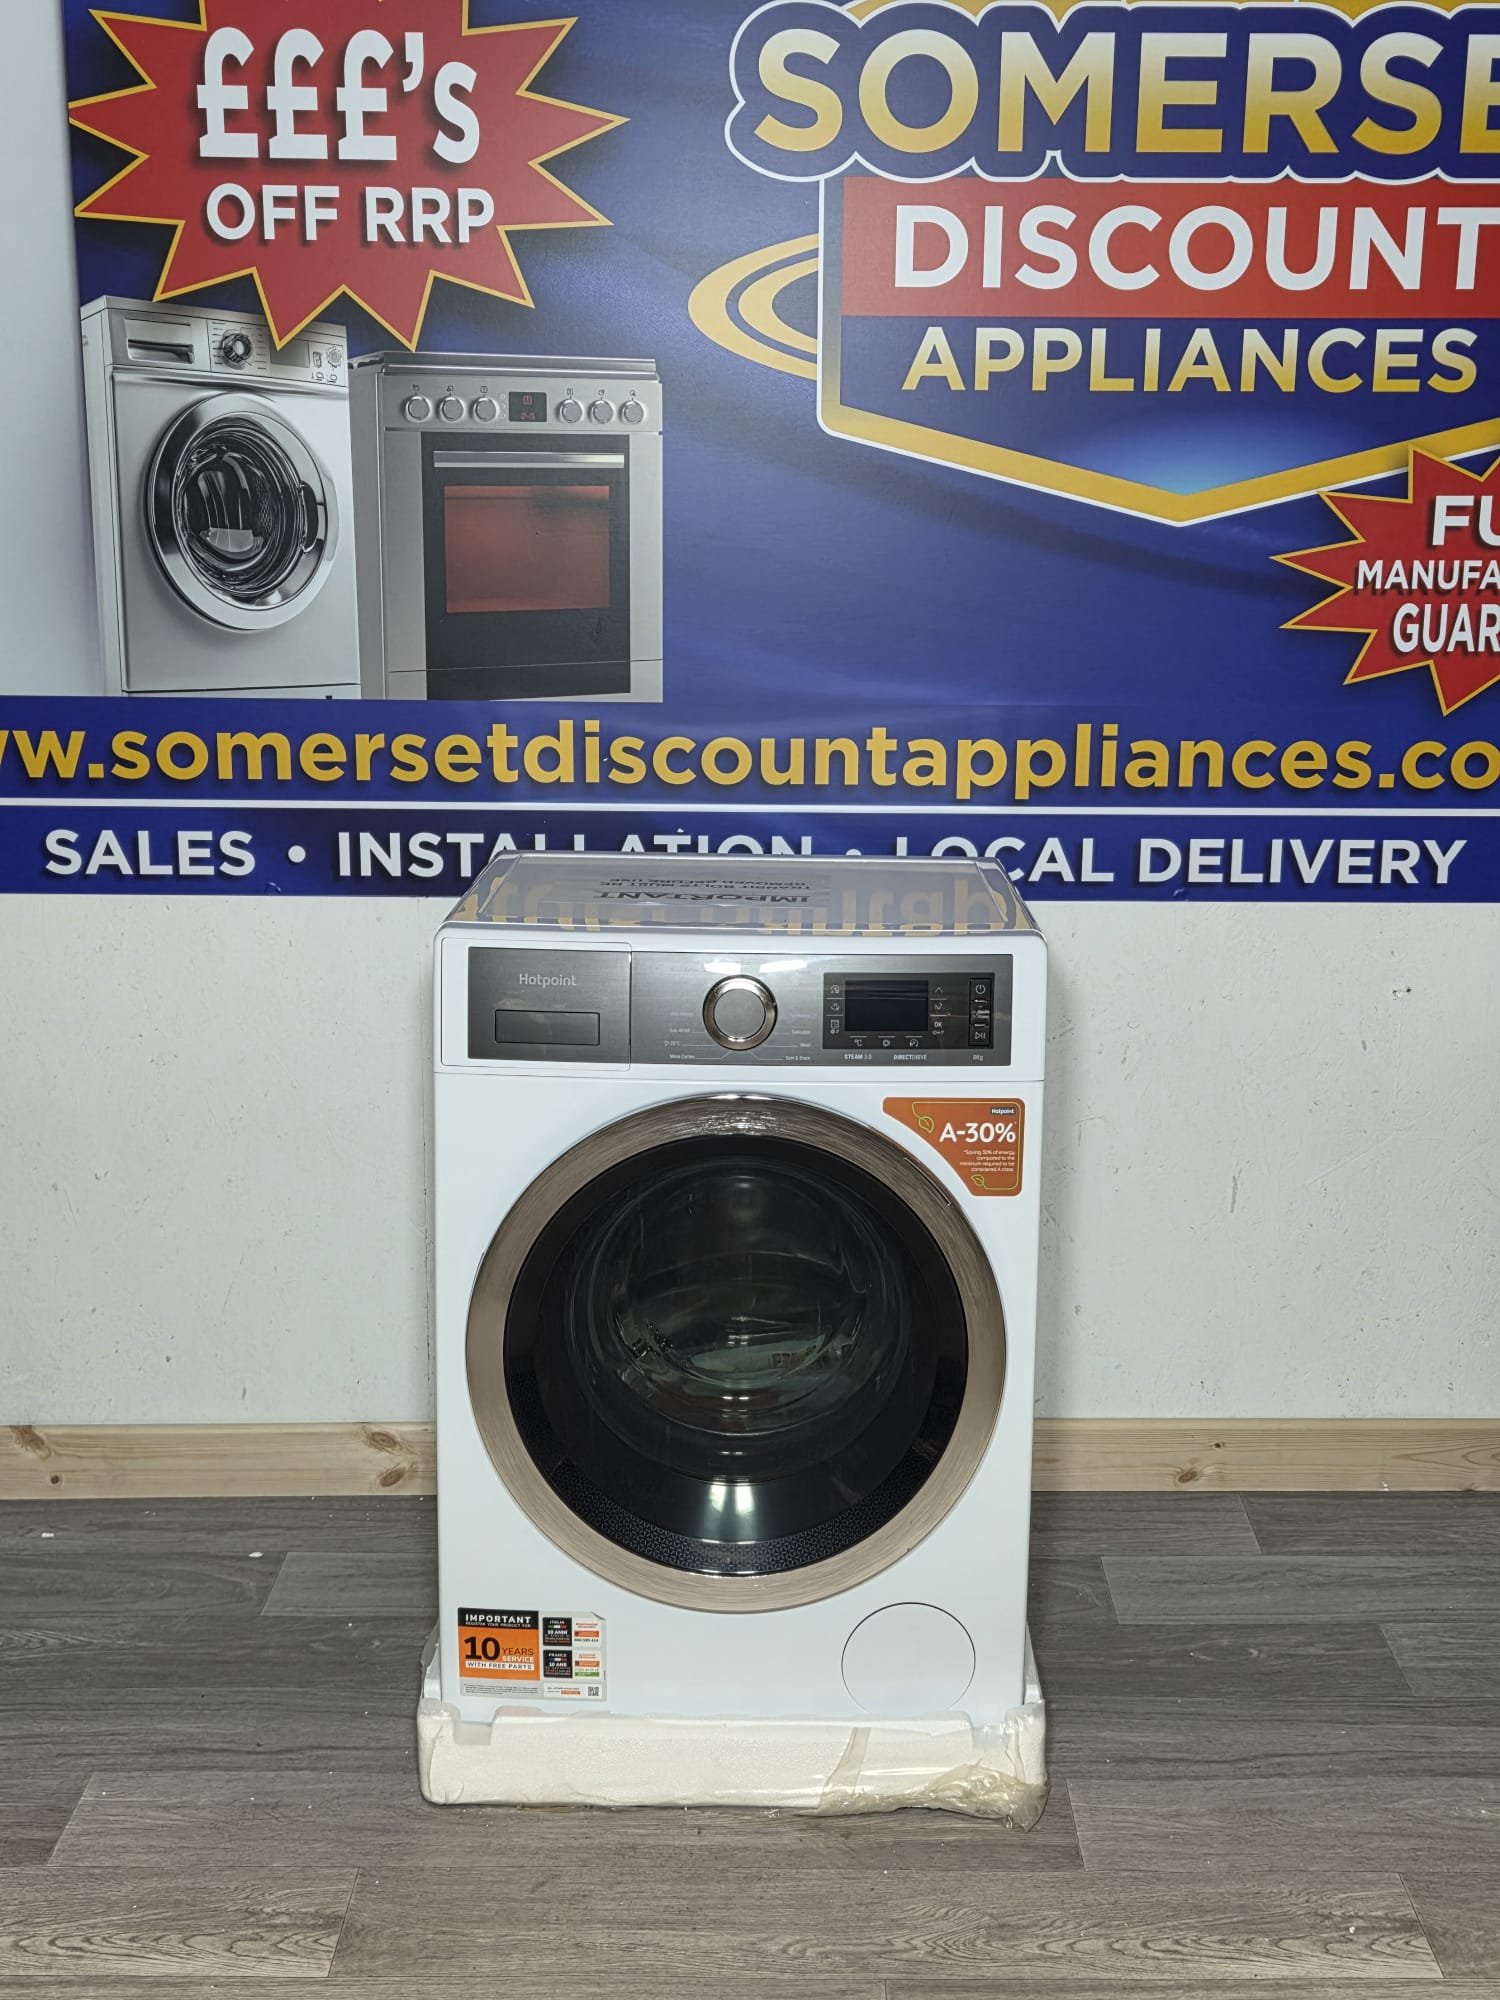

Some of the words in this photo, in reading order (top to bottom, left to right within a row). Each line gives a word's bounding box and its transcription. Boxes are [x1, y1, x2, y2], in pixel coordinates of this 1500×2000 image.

[206, 183, 339, 241] OFF
[366, 186, 495, 243] RRP
[895, 204, 1500, 291] DISCOUNT
[901, 326, 1478, 394] APPLIANCES
[1357, 559, 1500, 590] MANUFA
[1393, 602, 1500, 653] GUAR
[0, 719, 1500, 800] w.somersetdiscountappliances.co
[45, 829, 256, 878] SALES
[1139, 837, 1467, 884] DELIVERY
[597, 891, 809, 903] IMPORTANT
[519, 973, 577, 988] Hotpoint
[465, 1613, 531, 1624] IMPORTANT
[464, 1636, 500, 1660] 10
[502, 1647, 534, 1656] YEARS
[502, 1655, 534, 1663] SERVICE
